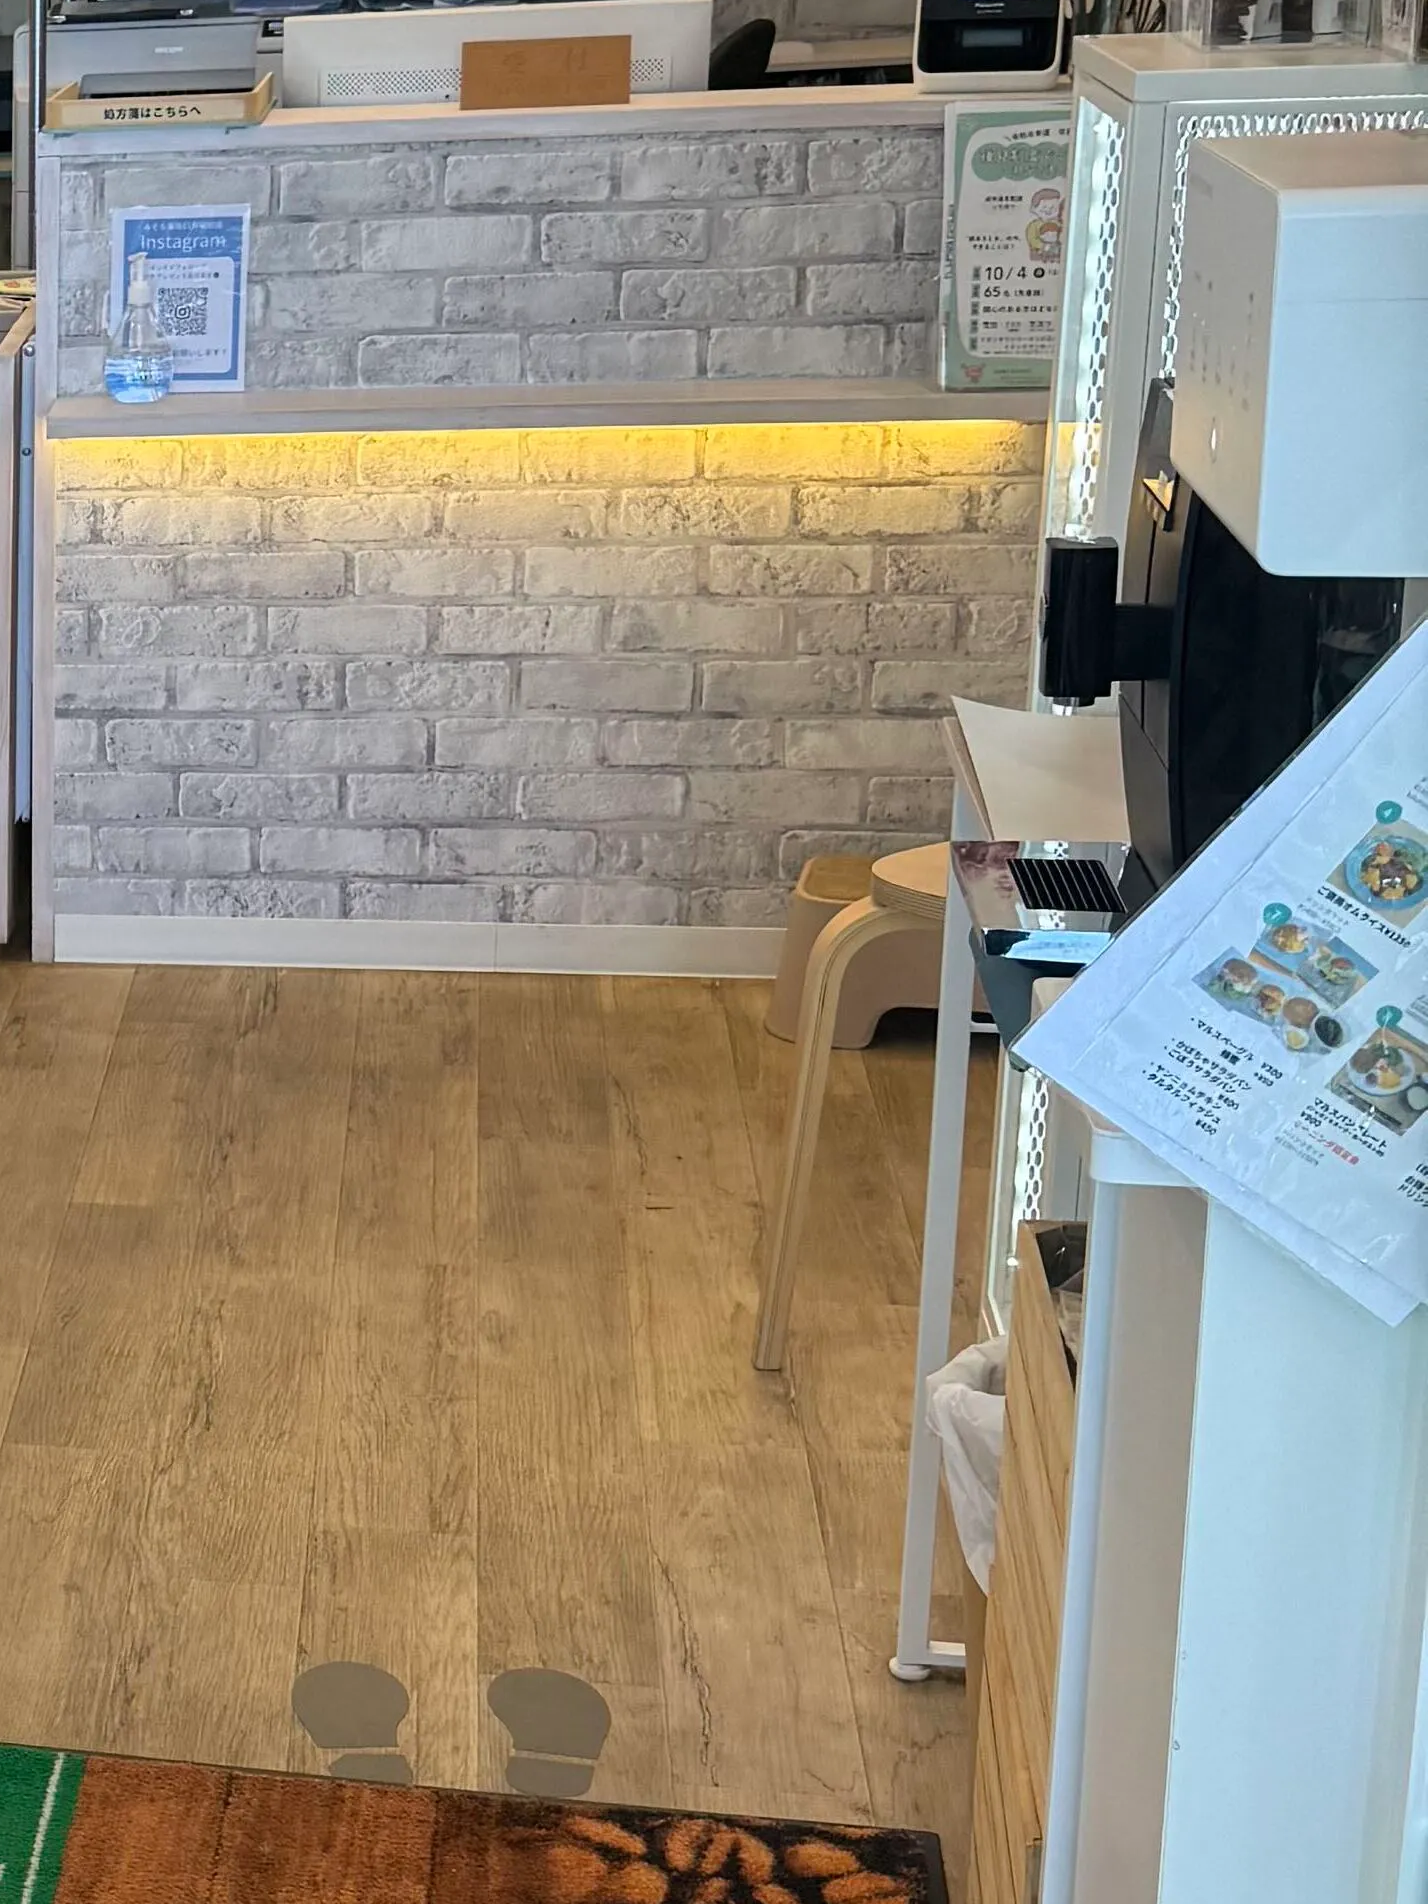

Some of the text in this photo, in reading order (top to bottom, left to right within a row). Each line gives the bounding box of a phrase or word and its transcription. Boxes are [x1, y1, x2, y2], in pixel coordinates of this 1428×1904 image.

[104, 105, 202, 120] 処方箋はこちらへ
[141, 234, 227, 253] Instagram
